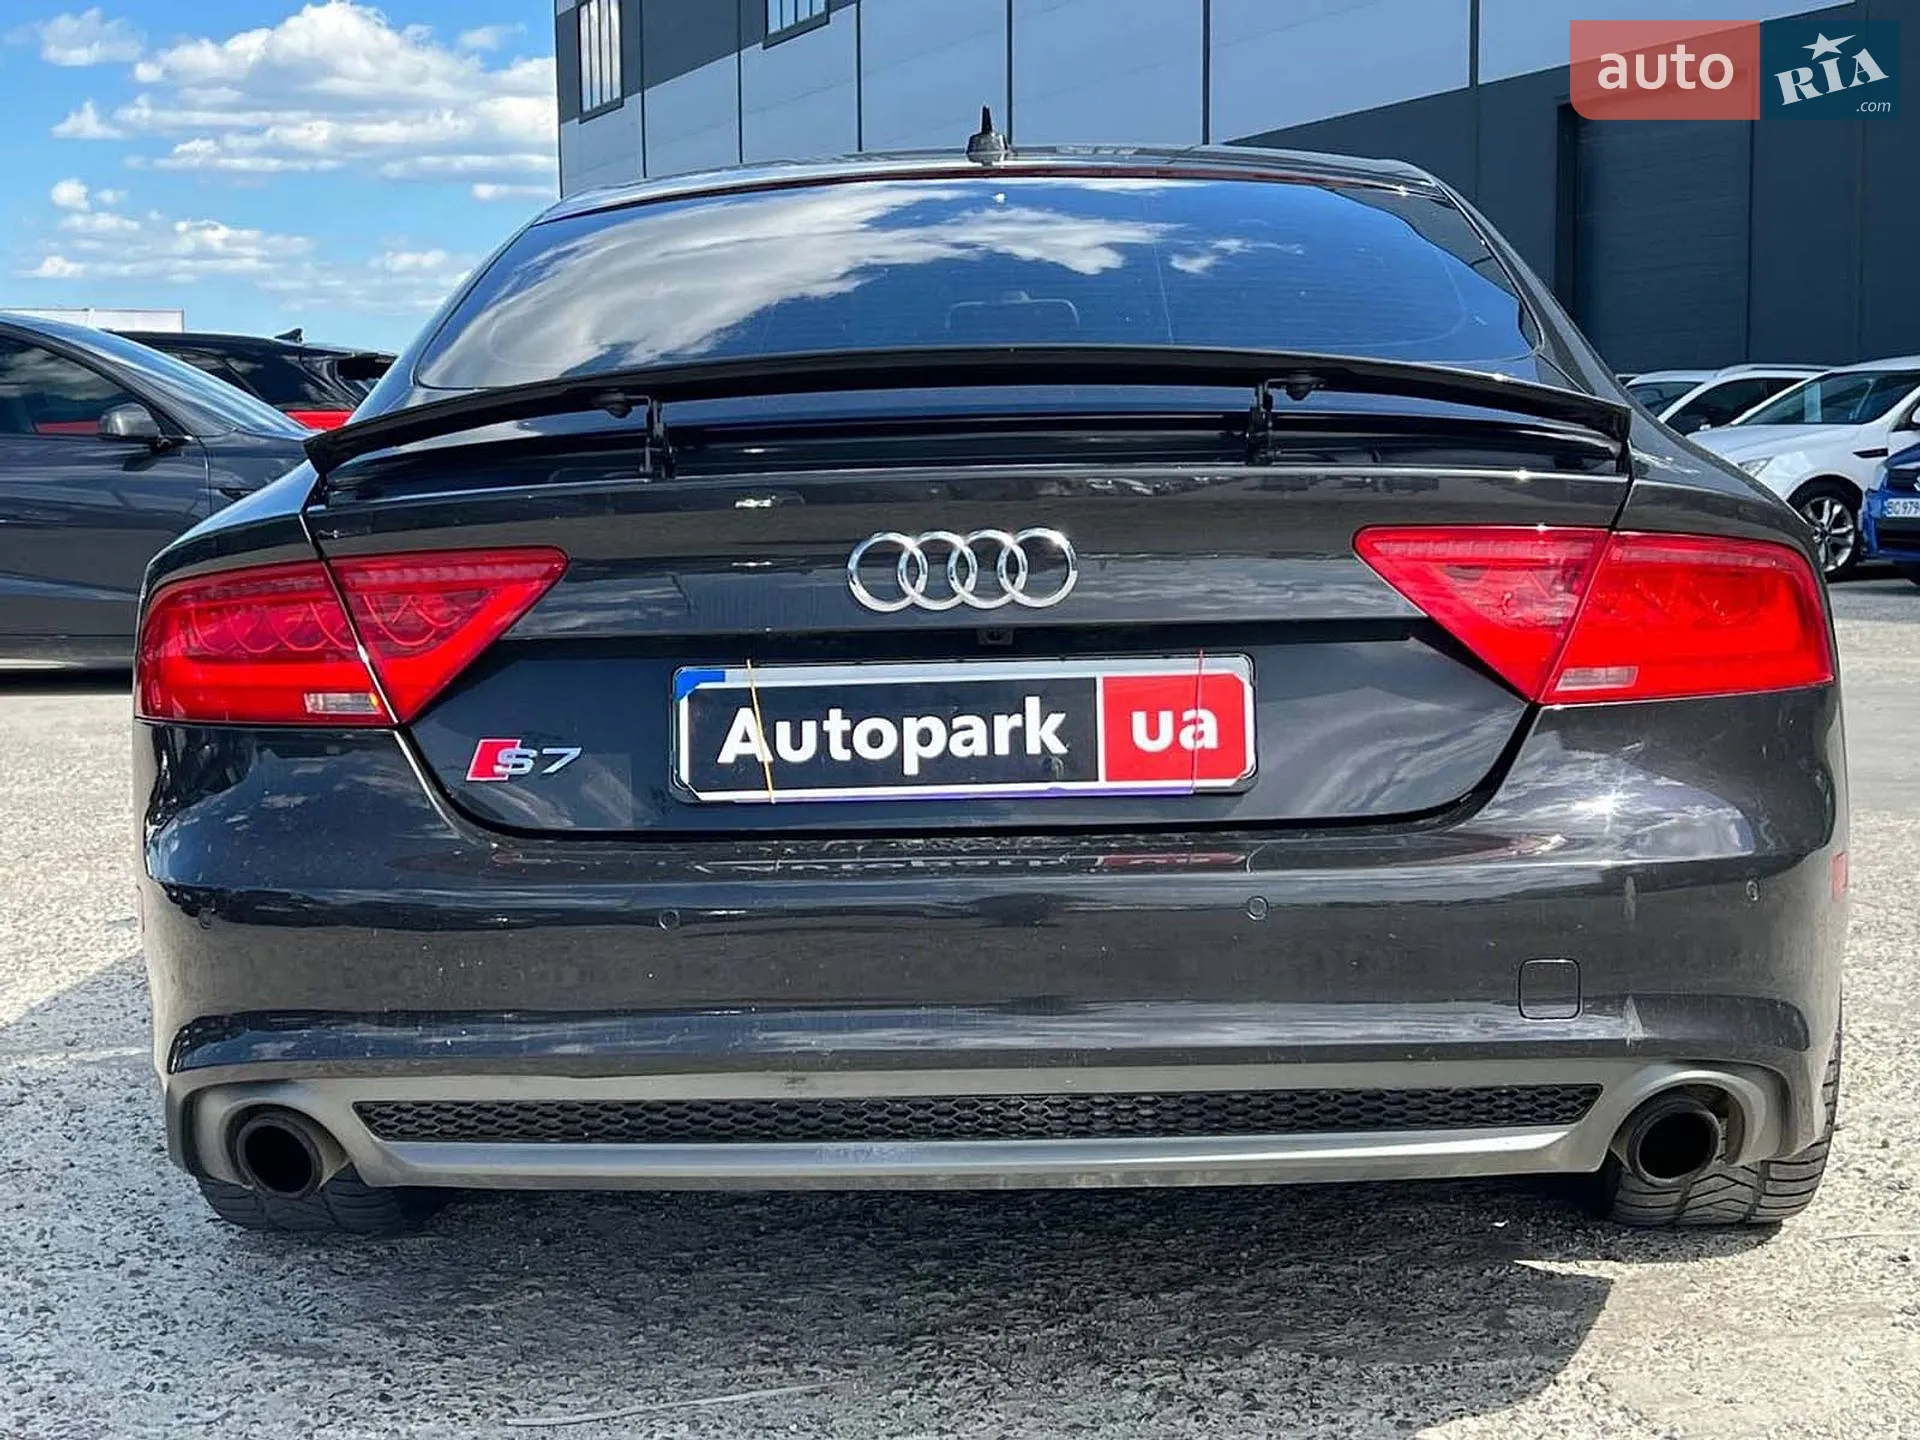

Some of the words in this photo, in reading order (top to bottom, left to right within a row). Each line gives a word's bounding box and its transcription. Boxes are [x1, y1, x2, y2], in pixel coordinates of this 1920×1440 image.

[491, 746, 583, 776] S7
[716, 695, 1068, 776] Autopark
[1131, 706, 1219, 754] ua
